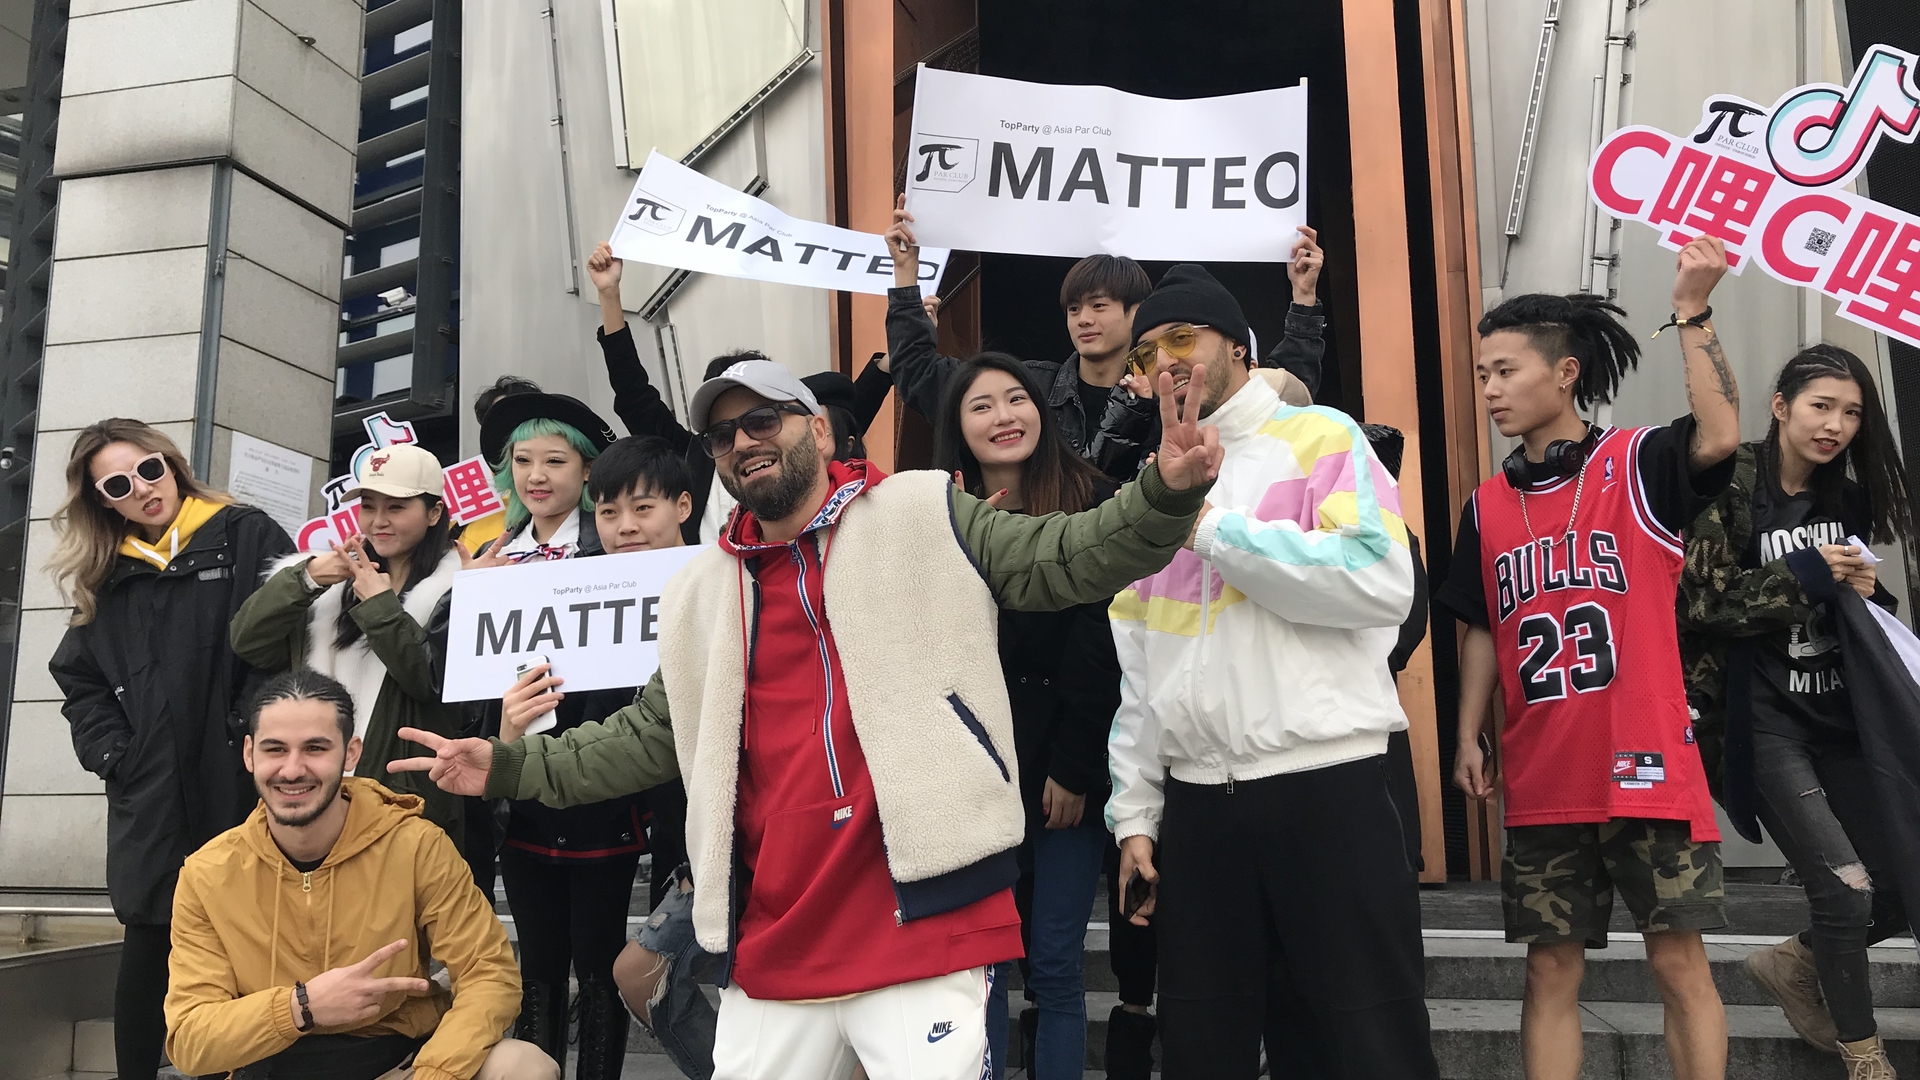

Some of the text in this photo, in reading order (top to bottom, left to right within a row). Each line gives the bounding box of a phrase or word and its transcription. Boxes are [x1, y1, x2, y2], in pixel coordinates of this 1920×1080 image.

[999, 119, 1112, 137] TopParty @ Asia Par Club
[1717, 134, 1760, 155] PAR CLUB
[933, 170, 969, 180] PAR CLUB
[987, 141, 1299, 210] MATTEO
[706, 203, 738, 217] TopParty
[748, 215, 764, 225] Asia
[764, 222, 776, 232] Par
[776, 230, 793, 238] Club
[1494, 529, 1629, 625] BULLS
[553, 580, 637, 596] TopParty @ Asia Par Club
[1517, 600, 1617, 704] 23
[1615, 760, 1631, 768] NIKE
[1643, 755, 1653, 765] S
[833, 805, 853, 822] NIKE
[931, 1020, 953, 1034] NIKE
